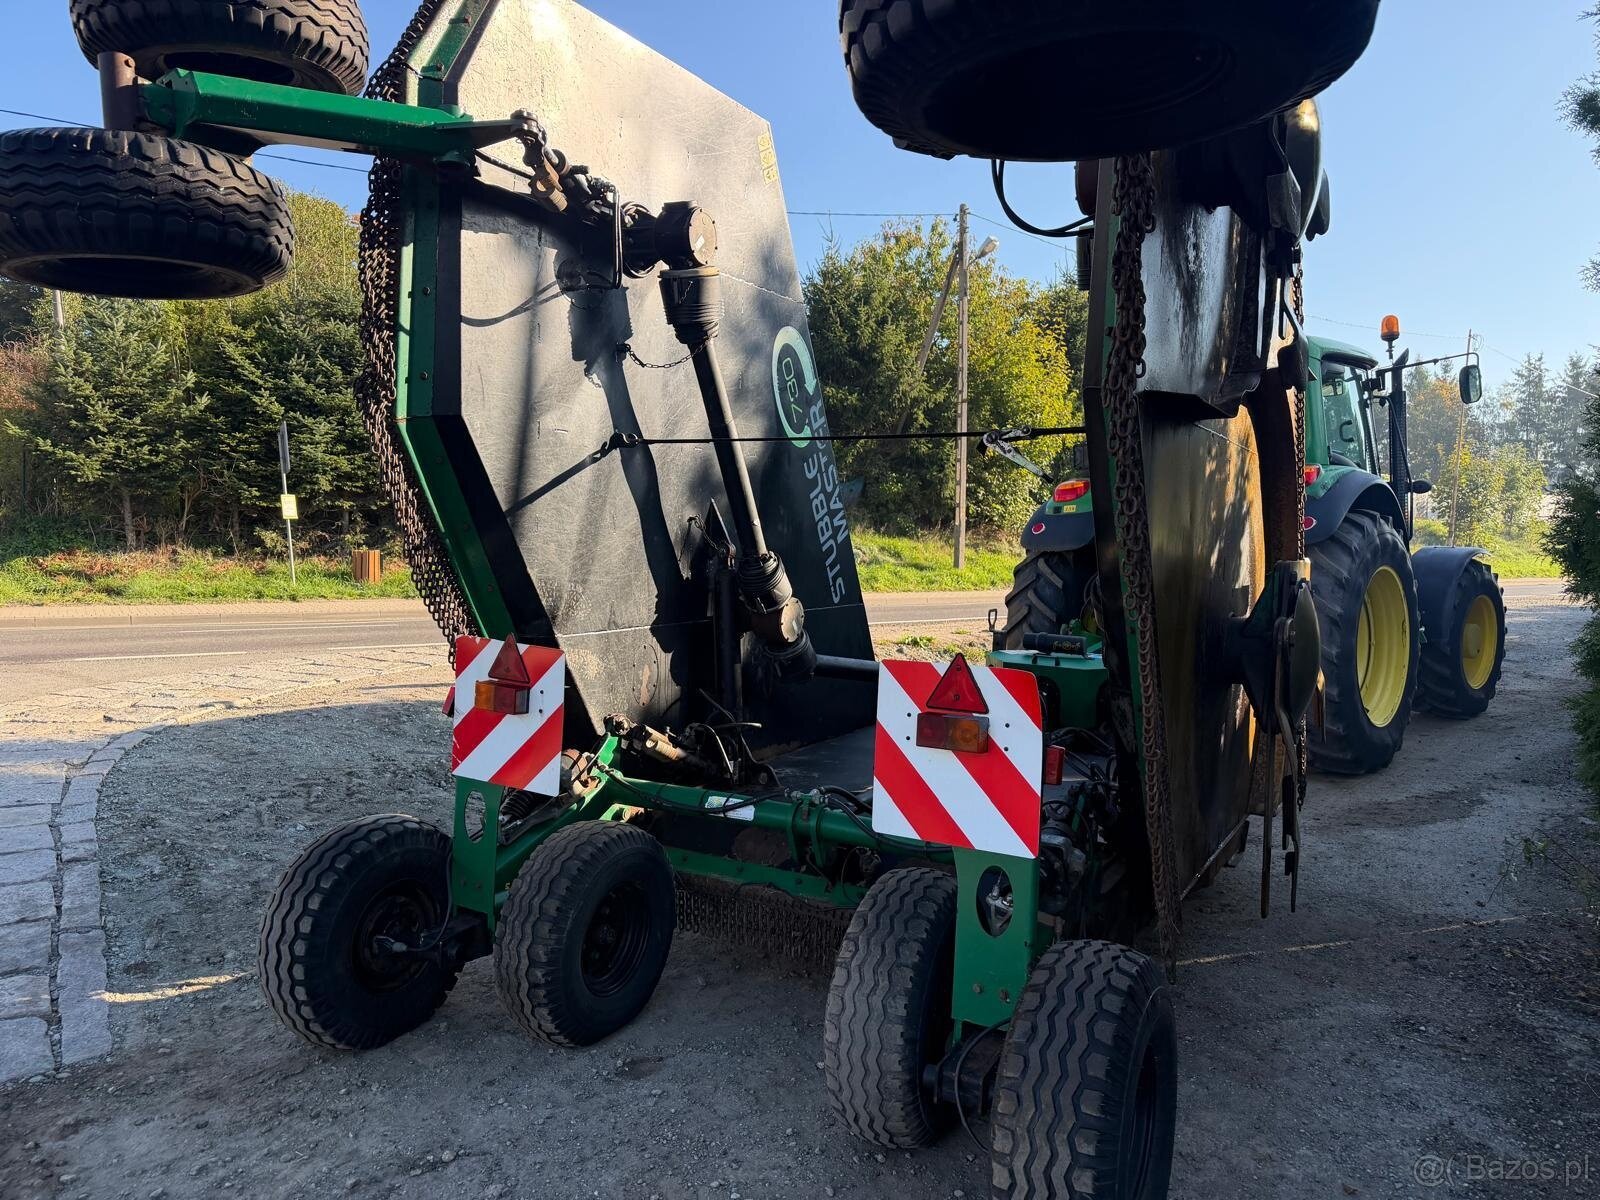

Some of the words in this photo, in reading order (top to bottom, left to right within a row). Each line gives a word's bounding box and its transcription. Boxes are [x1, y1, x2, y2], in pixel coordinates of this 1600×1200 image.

[782, 357, 802, 424] 730
[804, 453, 846, 604] STUBBLE
[809, 399, 850, 545] MASTER
